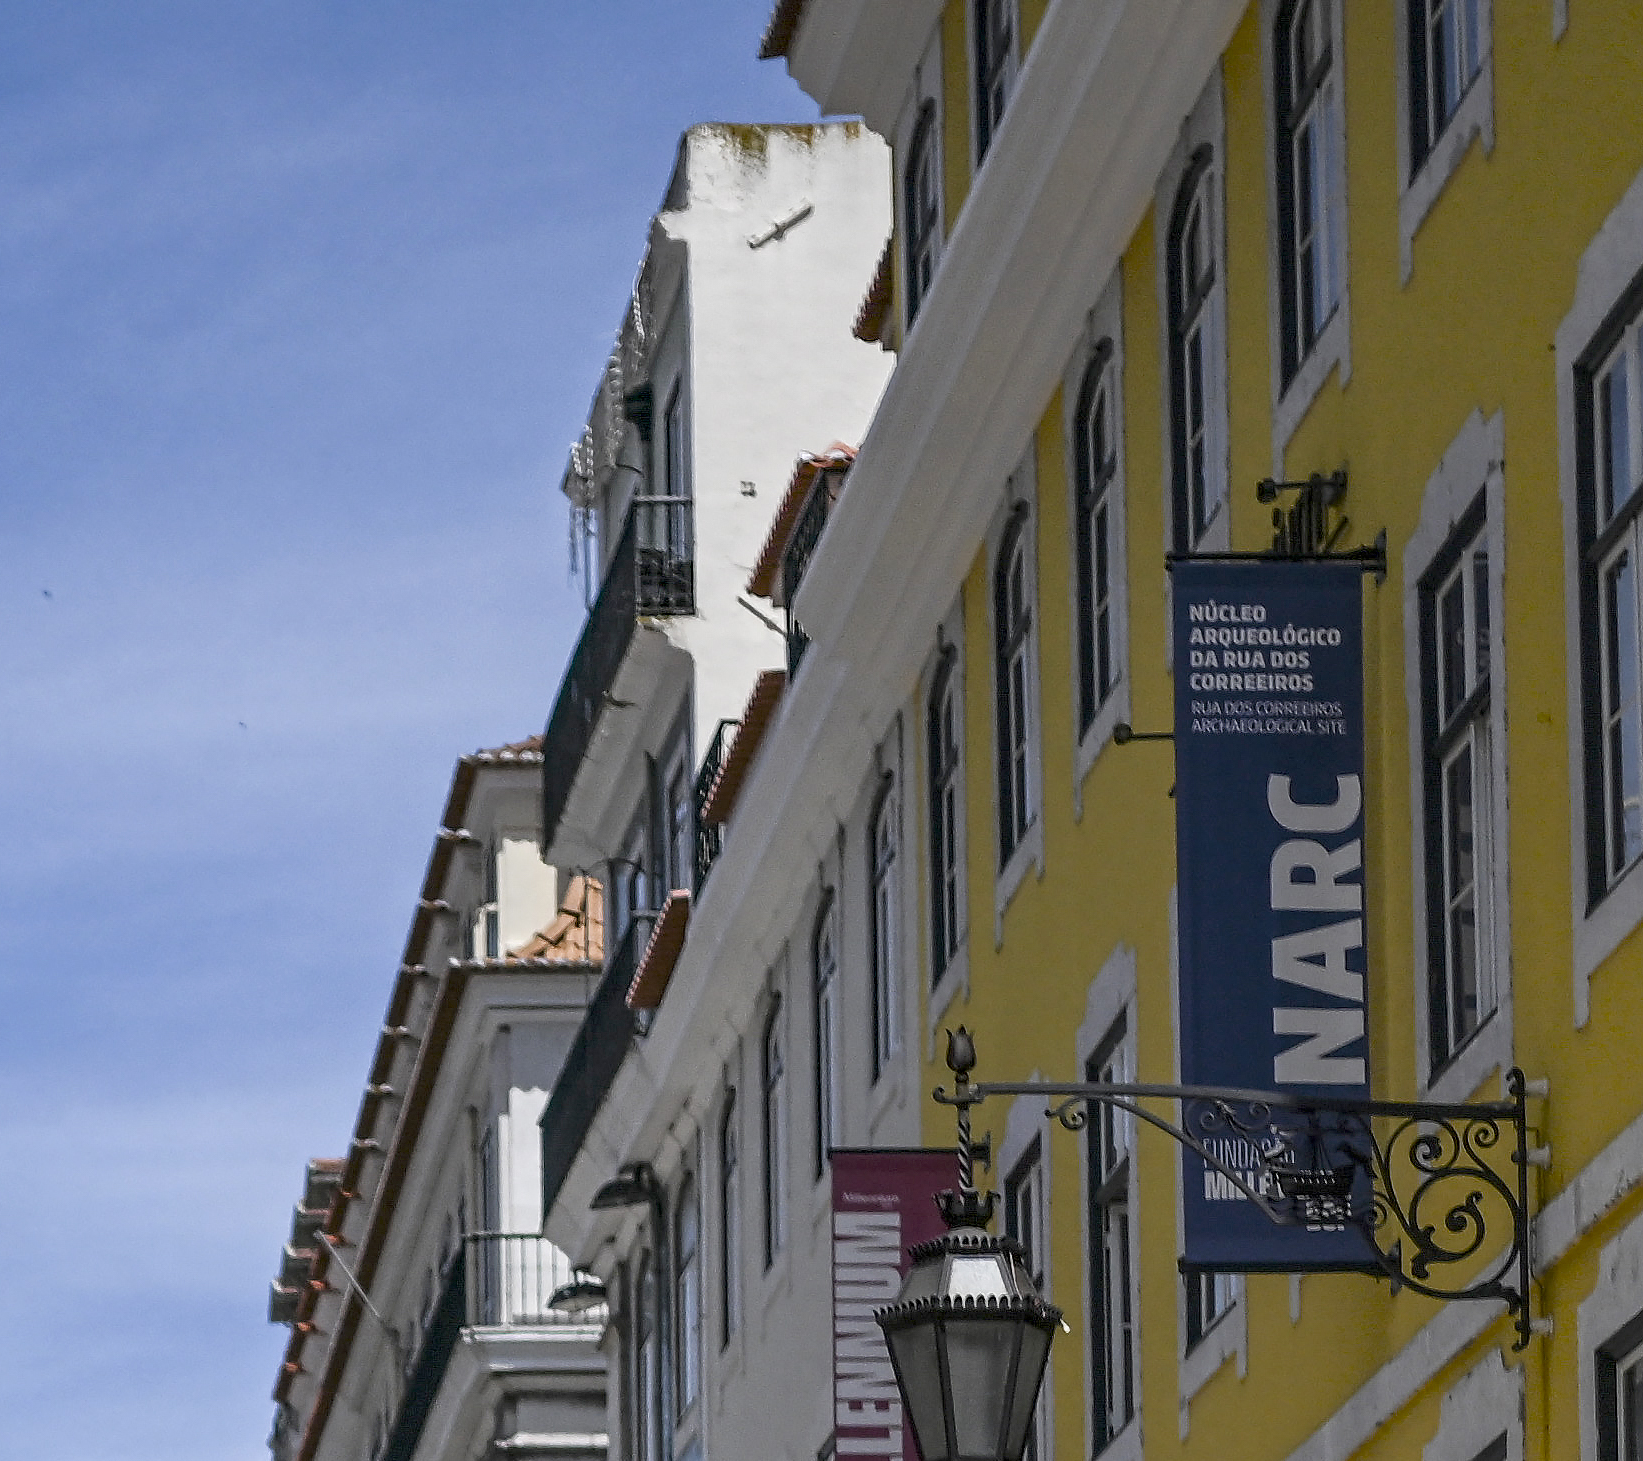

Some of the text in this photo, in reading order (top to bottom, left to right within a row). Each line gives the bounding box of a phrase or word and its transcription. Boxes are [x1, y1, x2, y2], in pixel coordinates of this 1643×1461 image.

[1189, 598, 1267, 622] NÚCLEO
[1190, 624, 1342, 648] ARQUEOLÓGICO
[1191, 651, 1311, 668] DA RUA DOS
[1190, 673, 1314, 691] CORREEIROS
[1191, 700, 1343, 716] RUA DOS CORREEIROS
[1191, 718, 1346, 735] ARCHAEOLOGICAL SITE
[1267, 773, 1366, 1085] NARC
